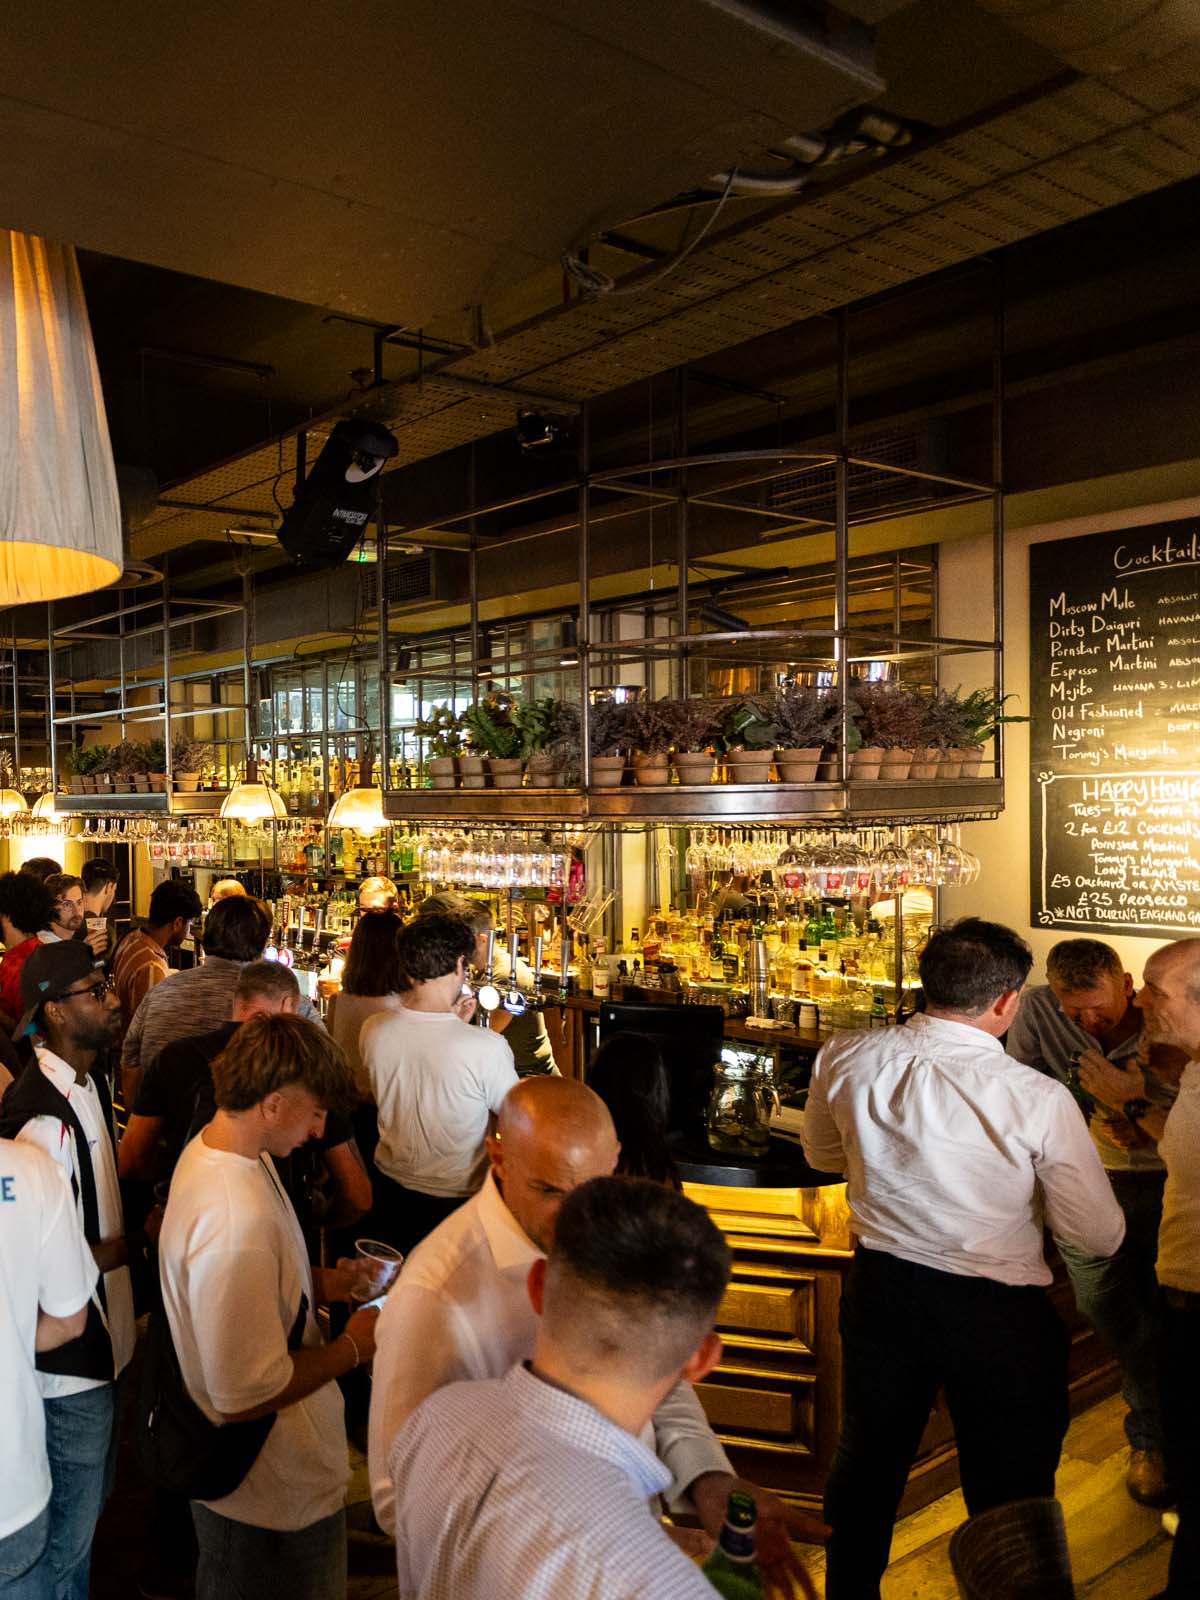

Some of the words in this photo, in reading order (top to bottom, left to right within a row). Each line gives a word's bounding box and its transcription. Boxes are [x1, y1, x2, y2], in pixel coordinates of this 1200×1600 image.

[1050, 592, 1097, 617] Moscow
[1101, 587, 1135, 611] Mule
[1158, 593, 1199, 605] ABSOLUT
[1050, 619, 1085, 638] Dirty
[1051, 641, 1100, 657] Pornstar
[1107, 633, 1154, 653] Martini
[1051, 662, 1098, 680] Espresso
[1110, 654, 1157, 672] Martini
[1050, 678, 1093, 701] Mojito
[1113, 682, 1155, 693] HAVANA
[1052, 706, 1073, 720] Old
[1080, 701, 1143, 720] Fashioned
[1170, 703, 1200, 713] MAKE
[1053, 725, 1105, 741] Negroni
[1052, 744, 1109, 766] Tommy's
[1083, 778, 1148, 806] HAPPY
[1064, 822, 1079, 836] 2
[1103, 821, 1130, 835] £12
[1088, 853, 1136, 869] Tommy's
[1051, 874, 1071, 888] £5
[1078, 892, 1113, 906] £25
[1095, 907, 1138, 922] DURING
[1140, 909, 1186, 922] ENGLAND
